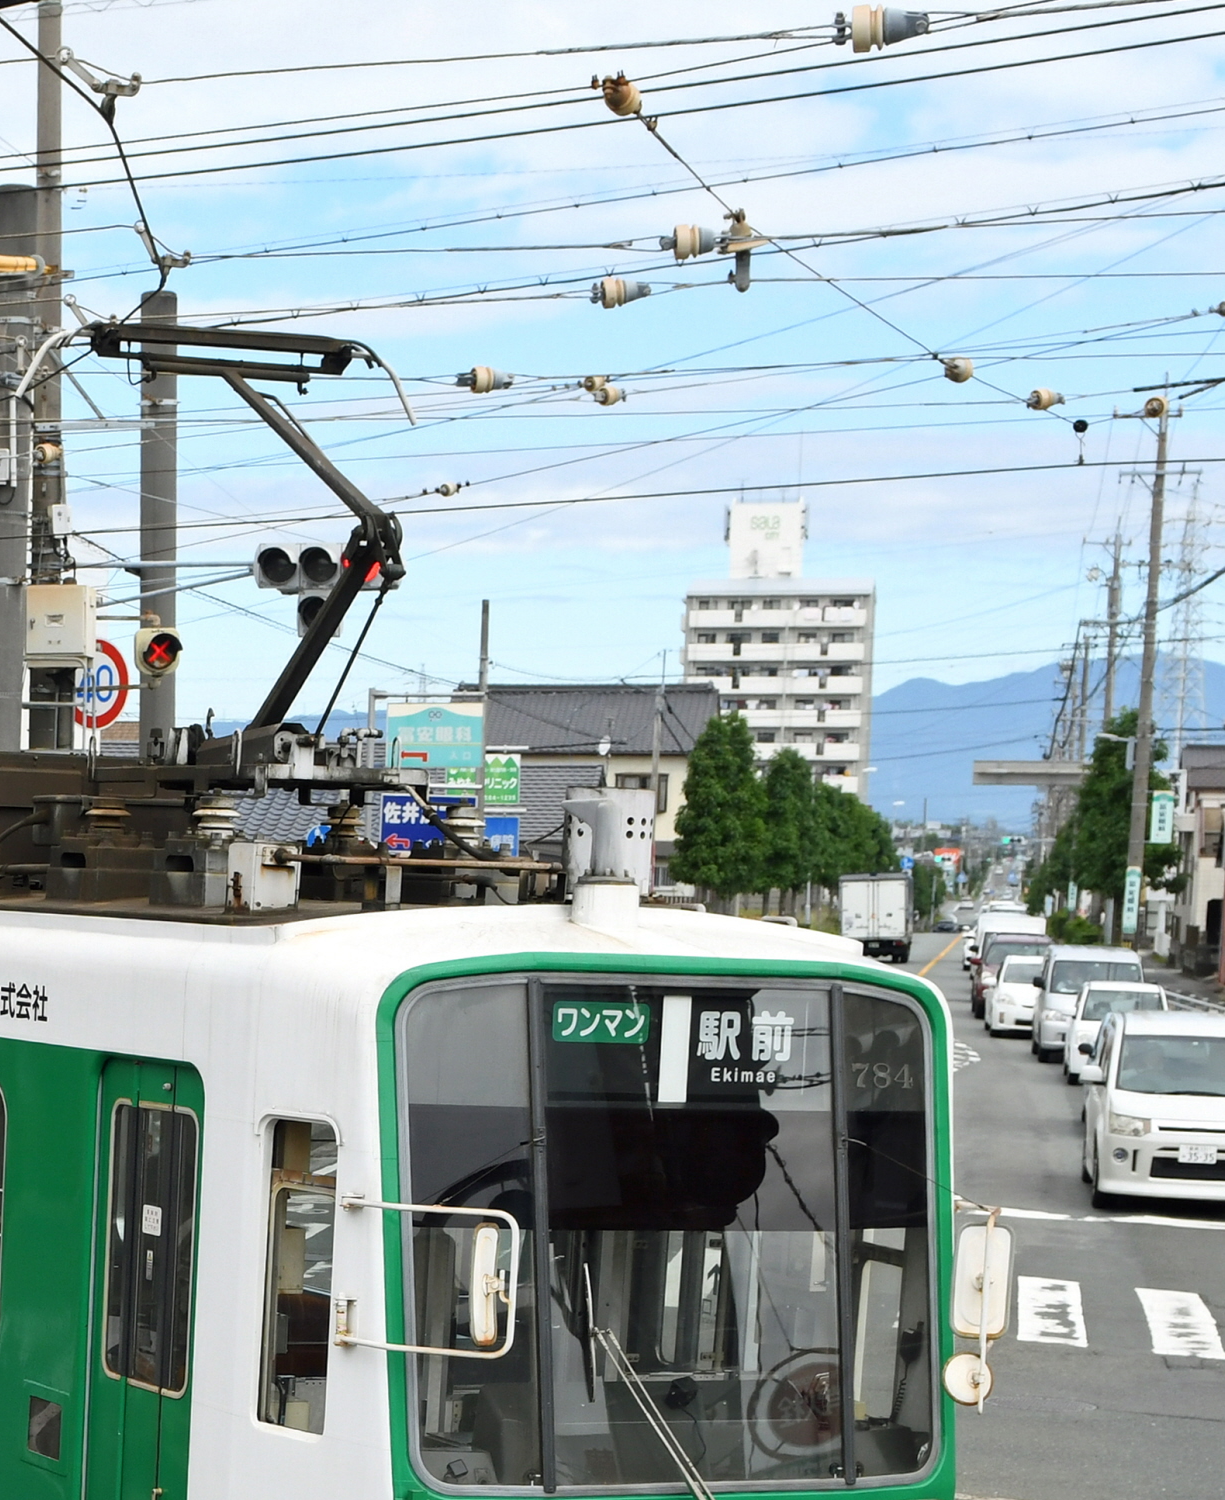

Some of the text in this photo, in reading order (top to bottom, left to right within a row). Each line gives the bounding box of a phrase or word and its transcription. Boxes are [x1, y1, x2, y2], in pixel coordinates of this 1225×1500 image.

[77, 665, 113, 703] 40
[557, 1007, 646, 1038] ワンマン
[696, 1010, 794, 1062] 駅前
[710, 1067, 776, 1084] Ekimae
[852, 1062, 914, 1090] 784
